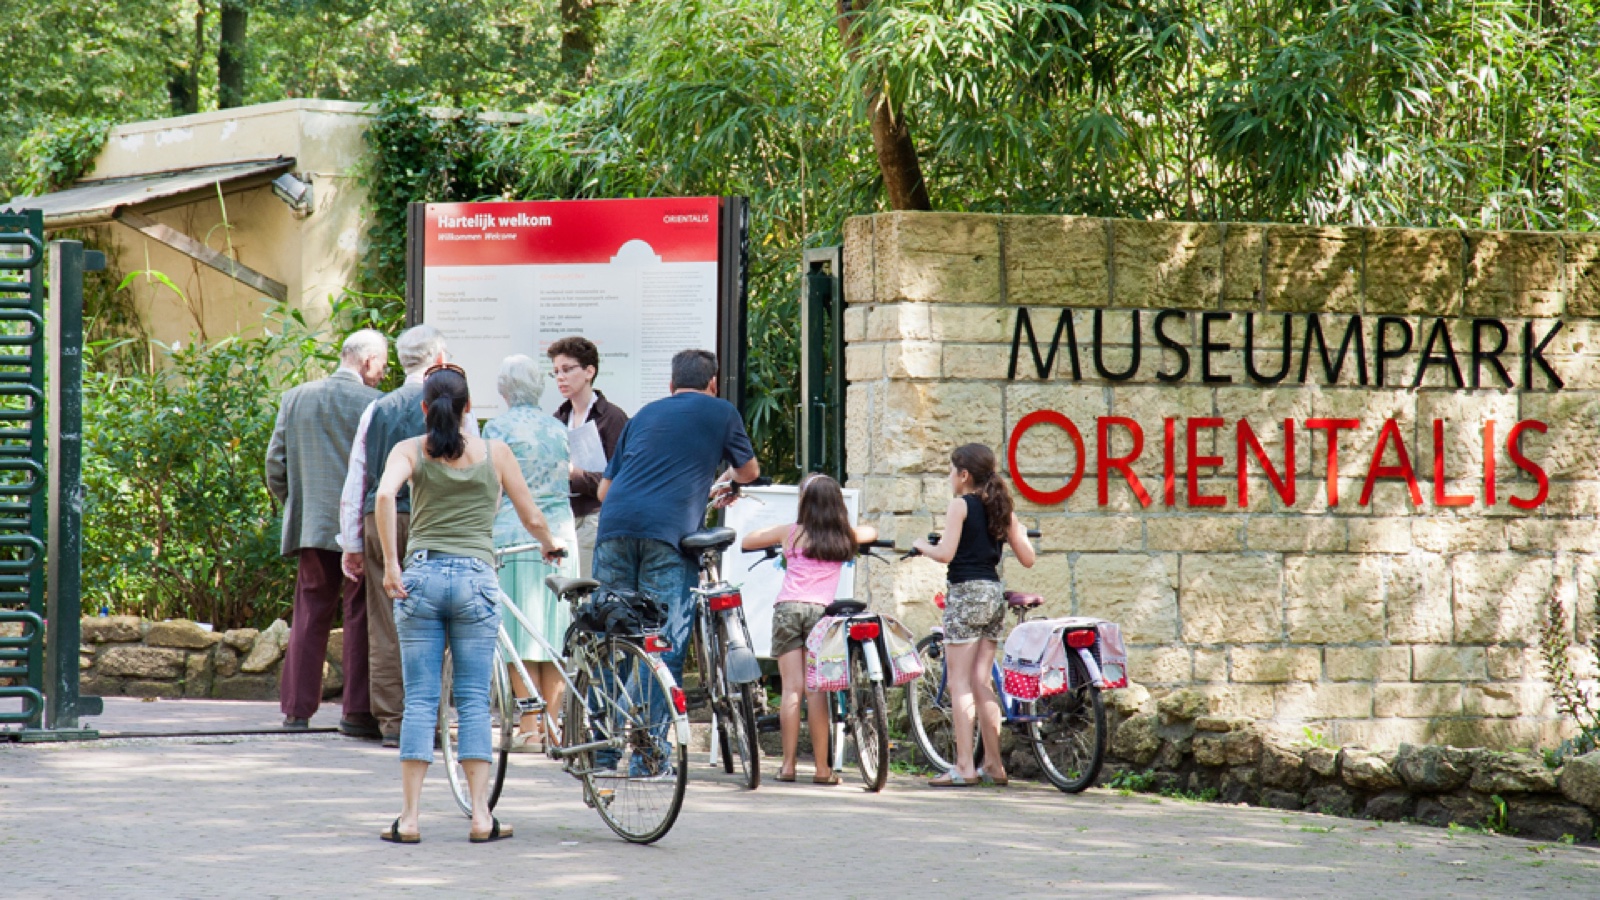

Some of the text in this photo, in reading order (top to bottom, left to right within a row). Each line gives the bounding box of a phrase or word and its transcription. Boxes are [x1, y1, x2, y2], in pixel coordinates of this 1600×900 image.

[438, 213, 552, 231] Hartelijk welkom
[662, 214, 709, 224] ORIENTALIS
[437, 232, 518, 241] Willkommen Welcome
[1006, 307, 1566, 389] MUSEUMPARK
[1007, 409, 1550, 509] ORIENTALIS
